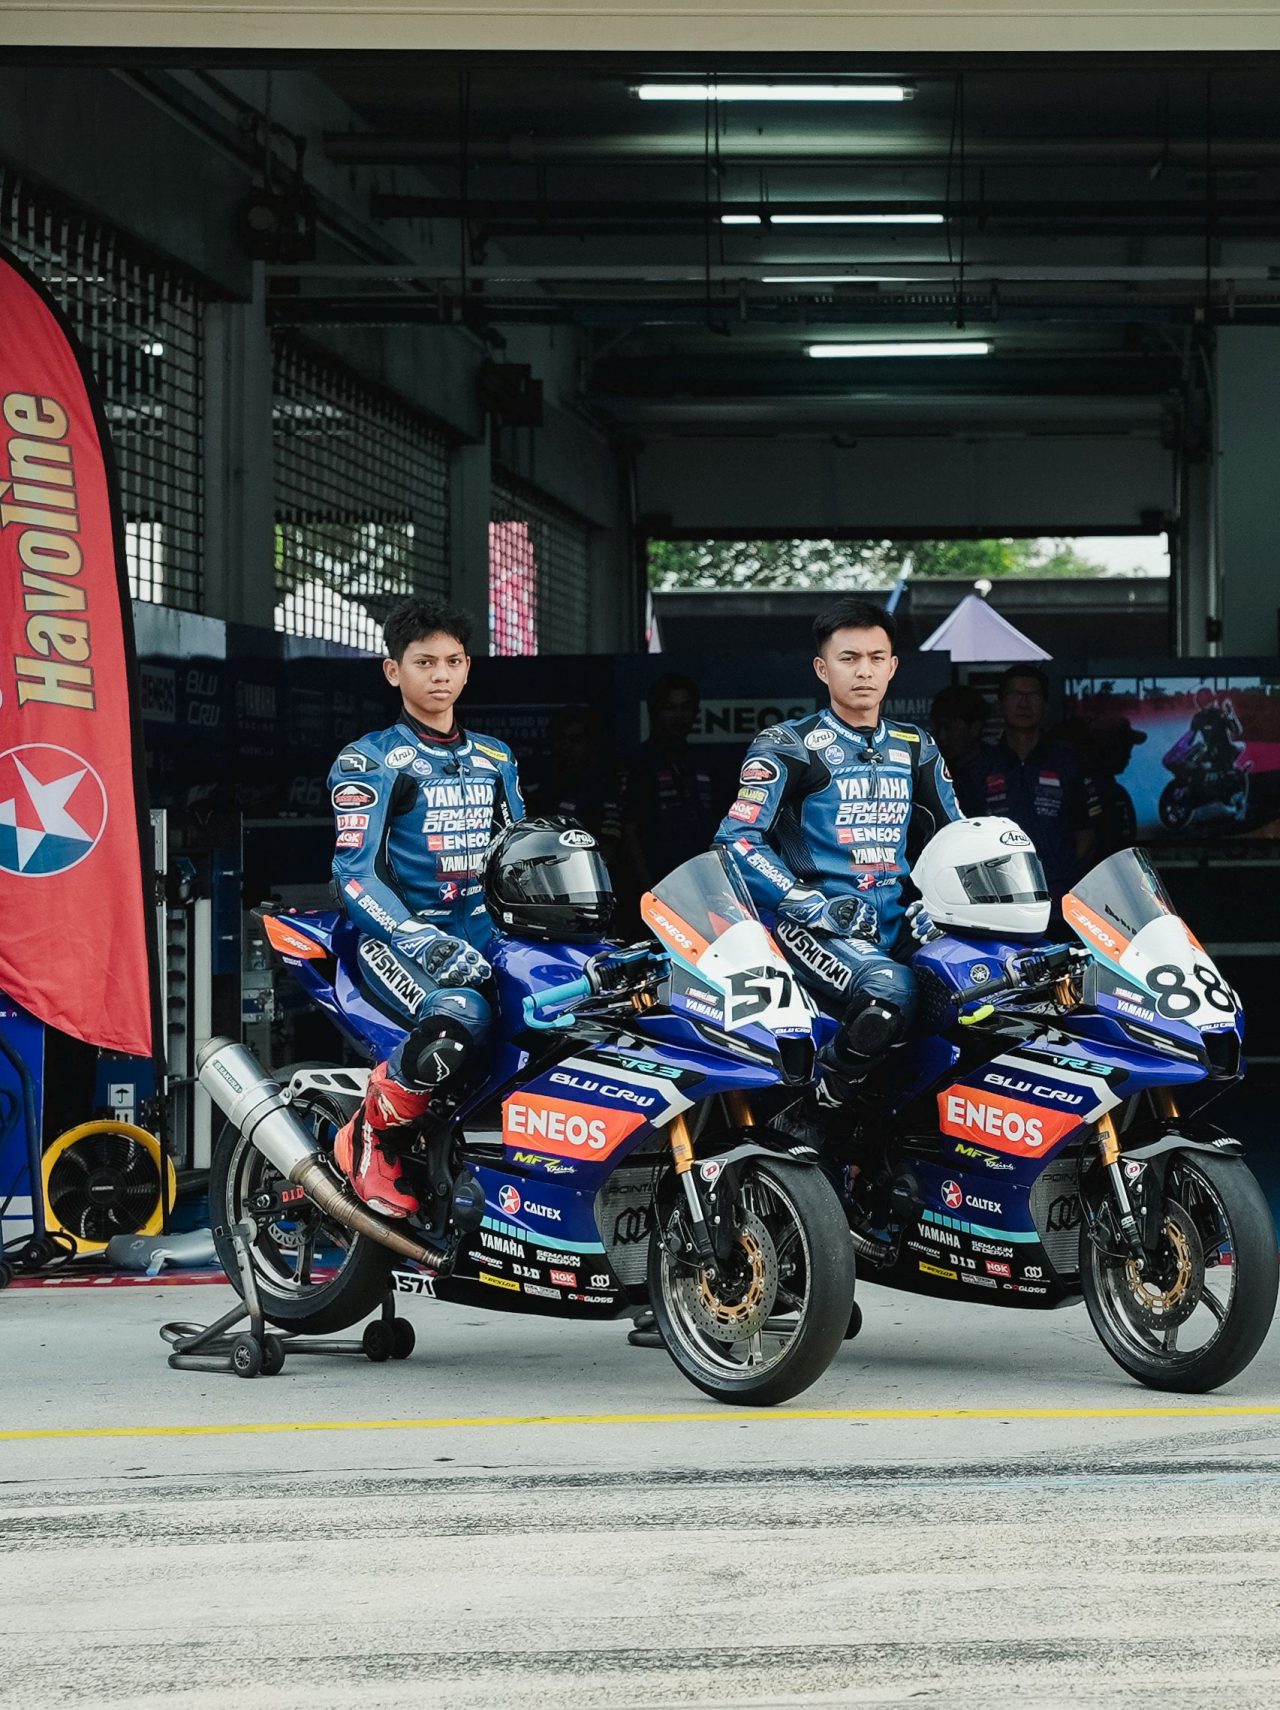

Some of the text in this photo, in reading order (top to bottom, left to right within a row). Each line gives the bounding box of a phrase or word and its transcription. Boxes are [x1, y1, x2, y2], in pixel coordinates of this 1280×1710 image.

[0, 391, 96, 711] Havoline
[186, 669, 218, 696] BLU
[187, 701, 221, 727] CRU
[423, 784, 494, 807] YAMAHA
[836, 778, 909, 800] YAMAHA
[426, 807, 494, 820] SEMAKIN
[838, 802, 909, 813] SEMAKIN
[422, 818, 492, 833] DI DEPAN
[835, 813, 906, 825] DI DEPAN
[444, 832, 491, 849] ENEOS
[854, 827, 900, 842] ENEOS
[656, 914, 693, 950] ENEOS
[1077, 914, 1116, 948] ENEOS
[723, 965, 793, 1023] 57
[1146, 963, 1236, 1019] 88
[685, 999, 724, 1021] YAMAHA
[1117, 1000, 1155, 1022] YAMAHA
[624, 1058, 683, 1079] R3
[1057, 1057, 1113, 1076] R3
[549, 1072, 655, 1106] BLU CRU
[984, 1073, 1084, 1105] BLU CRU
[508, 1104, 606, 1149] ENEOS
[947, 1095, 1043, 1147] ENEOS
[524, 1200, 561, 1221] CALTEX
[966, 1195, 1002, 1214] CALTEX
[480, 1232, 525, 1259] YAMAHA
[917, 1223, 961, 1249] YAMAHA
[971, 1240, 1013, 1253] SEMAKIN
[536, 1249, 580, 1261] SEMAKIN
[545, 1257, 580, 1267] DEPAN
[982, 1247, 1014, 1258] DEPAN
[551, 1272, 575, 1283] NGK
[927, 1266, 953, 1278] DUNLOP
[986, 1263, 1009, 1273] NGK
[487, 1276, 516, 1288] DUNLOP
